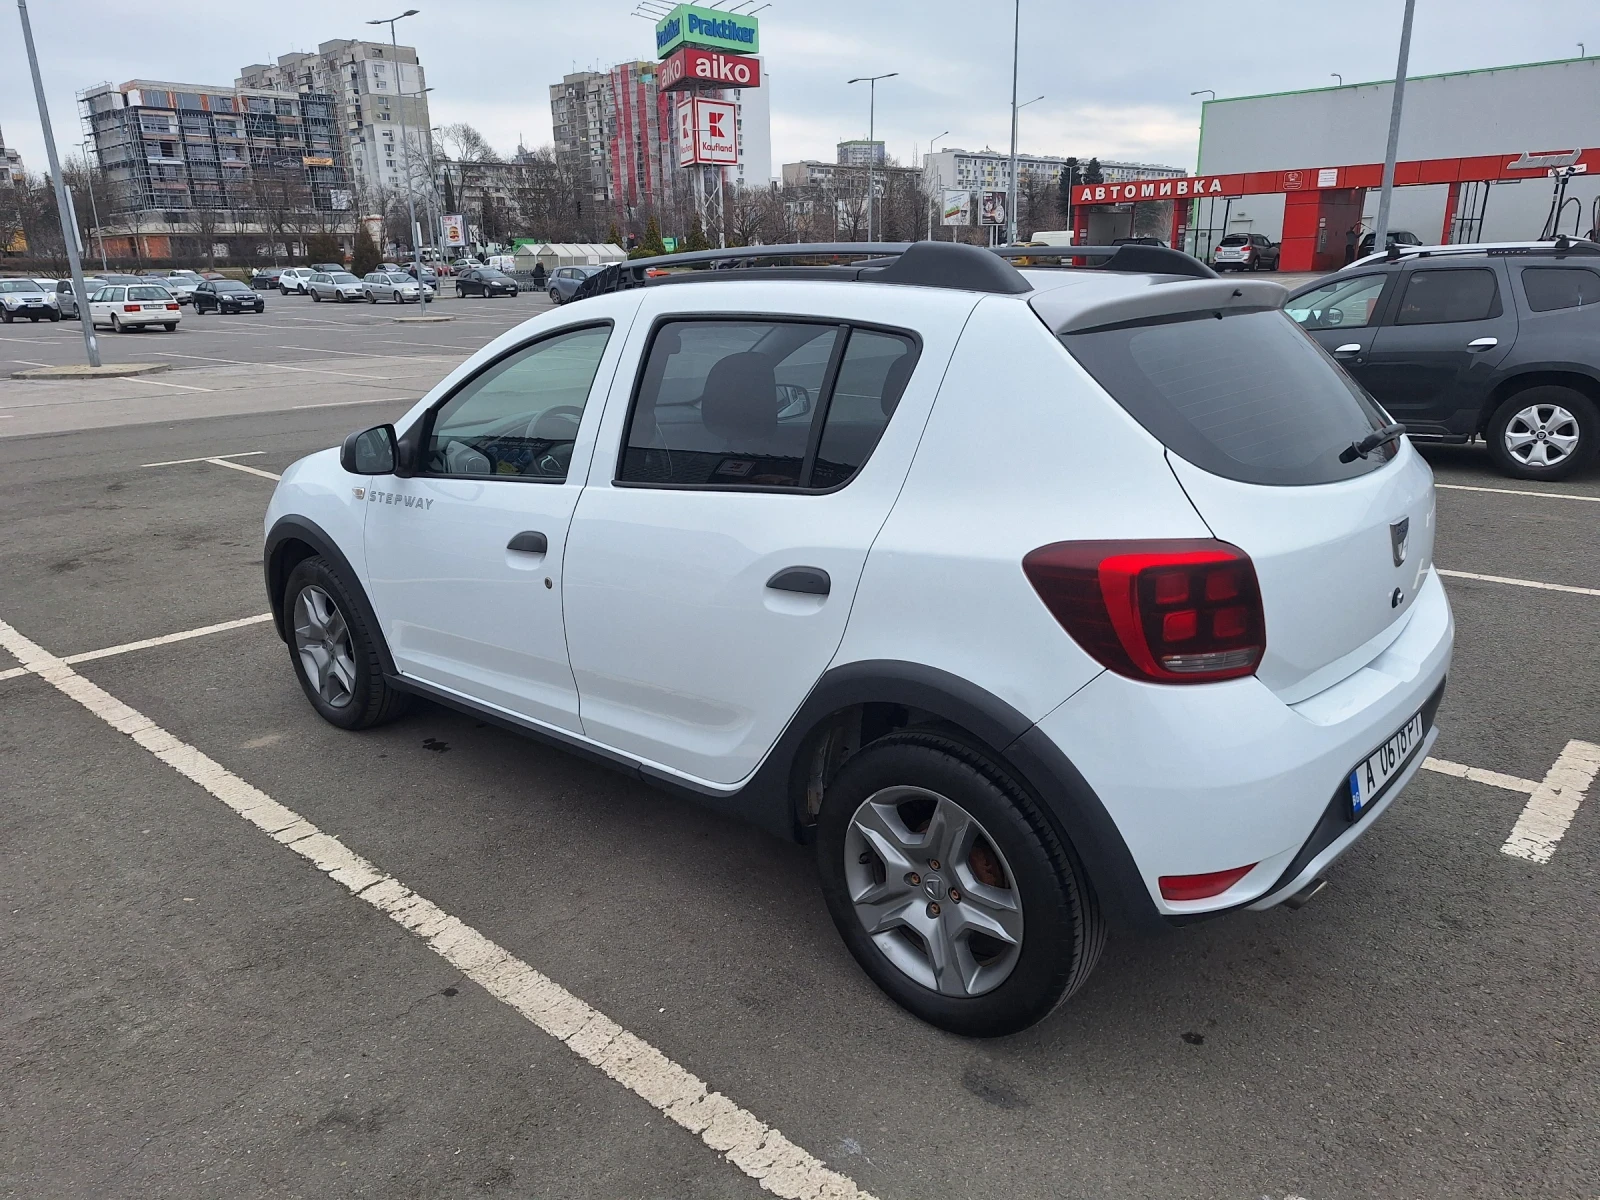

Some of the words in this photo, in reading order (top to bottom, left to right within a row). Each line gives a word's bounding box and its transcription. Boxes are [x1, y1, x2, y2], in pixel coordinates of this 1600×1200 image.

[688, 13, 755, 44] Praktiker
[661, 60, 681, 87] aiko
[695, 54, 751, 83] aiko
[709, 112, 725, 138] K
[702, 141, 732, 152] Kaufland
[1081, 179, 1222, 201] АВТОМИВКА
[369, 490, 434, 510] STEPWAY
